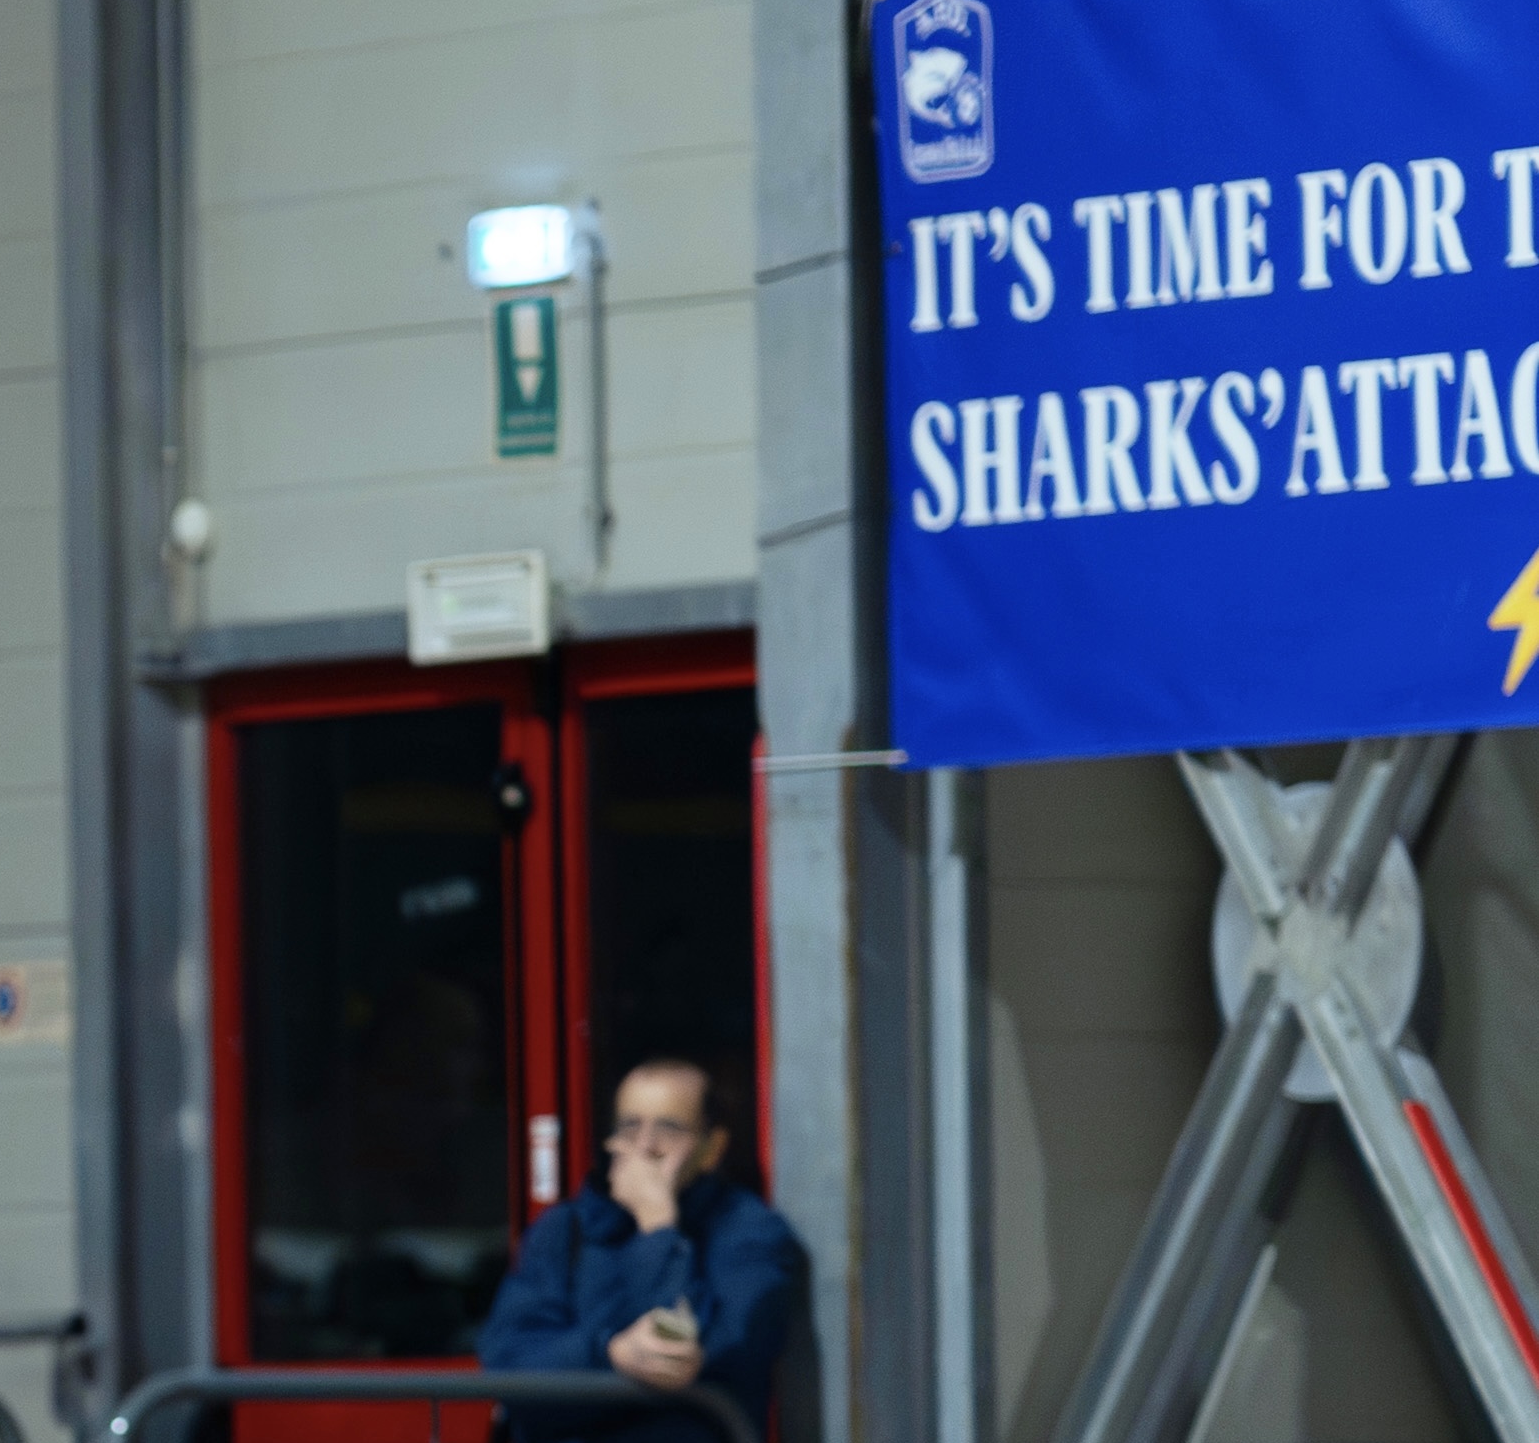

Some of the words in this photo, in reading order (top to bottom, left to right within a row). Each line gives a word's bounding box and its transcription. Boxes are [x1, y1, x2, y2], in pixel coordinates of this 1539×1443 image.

[909, 202, 1056, 333] IT'S
[1073, 177, 1275, 314] TIME
[1297, 157, 1472, 291] FOR
